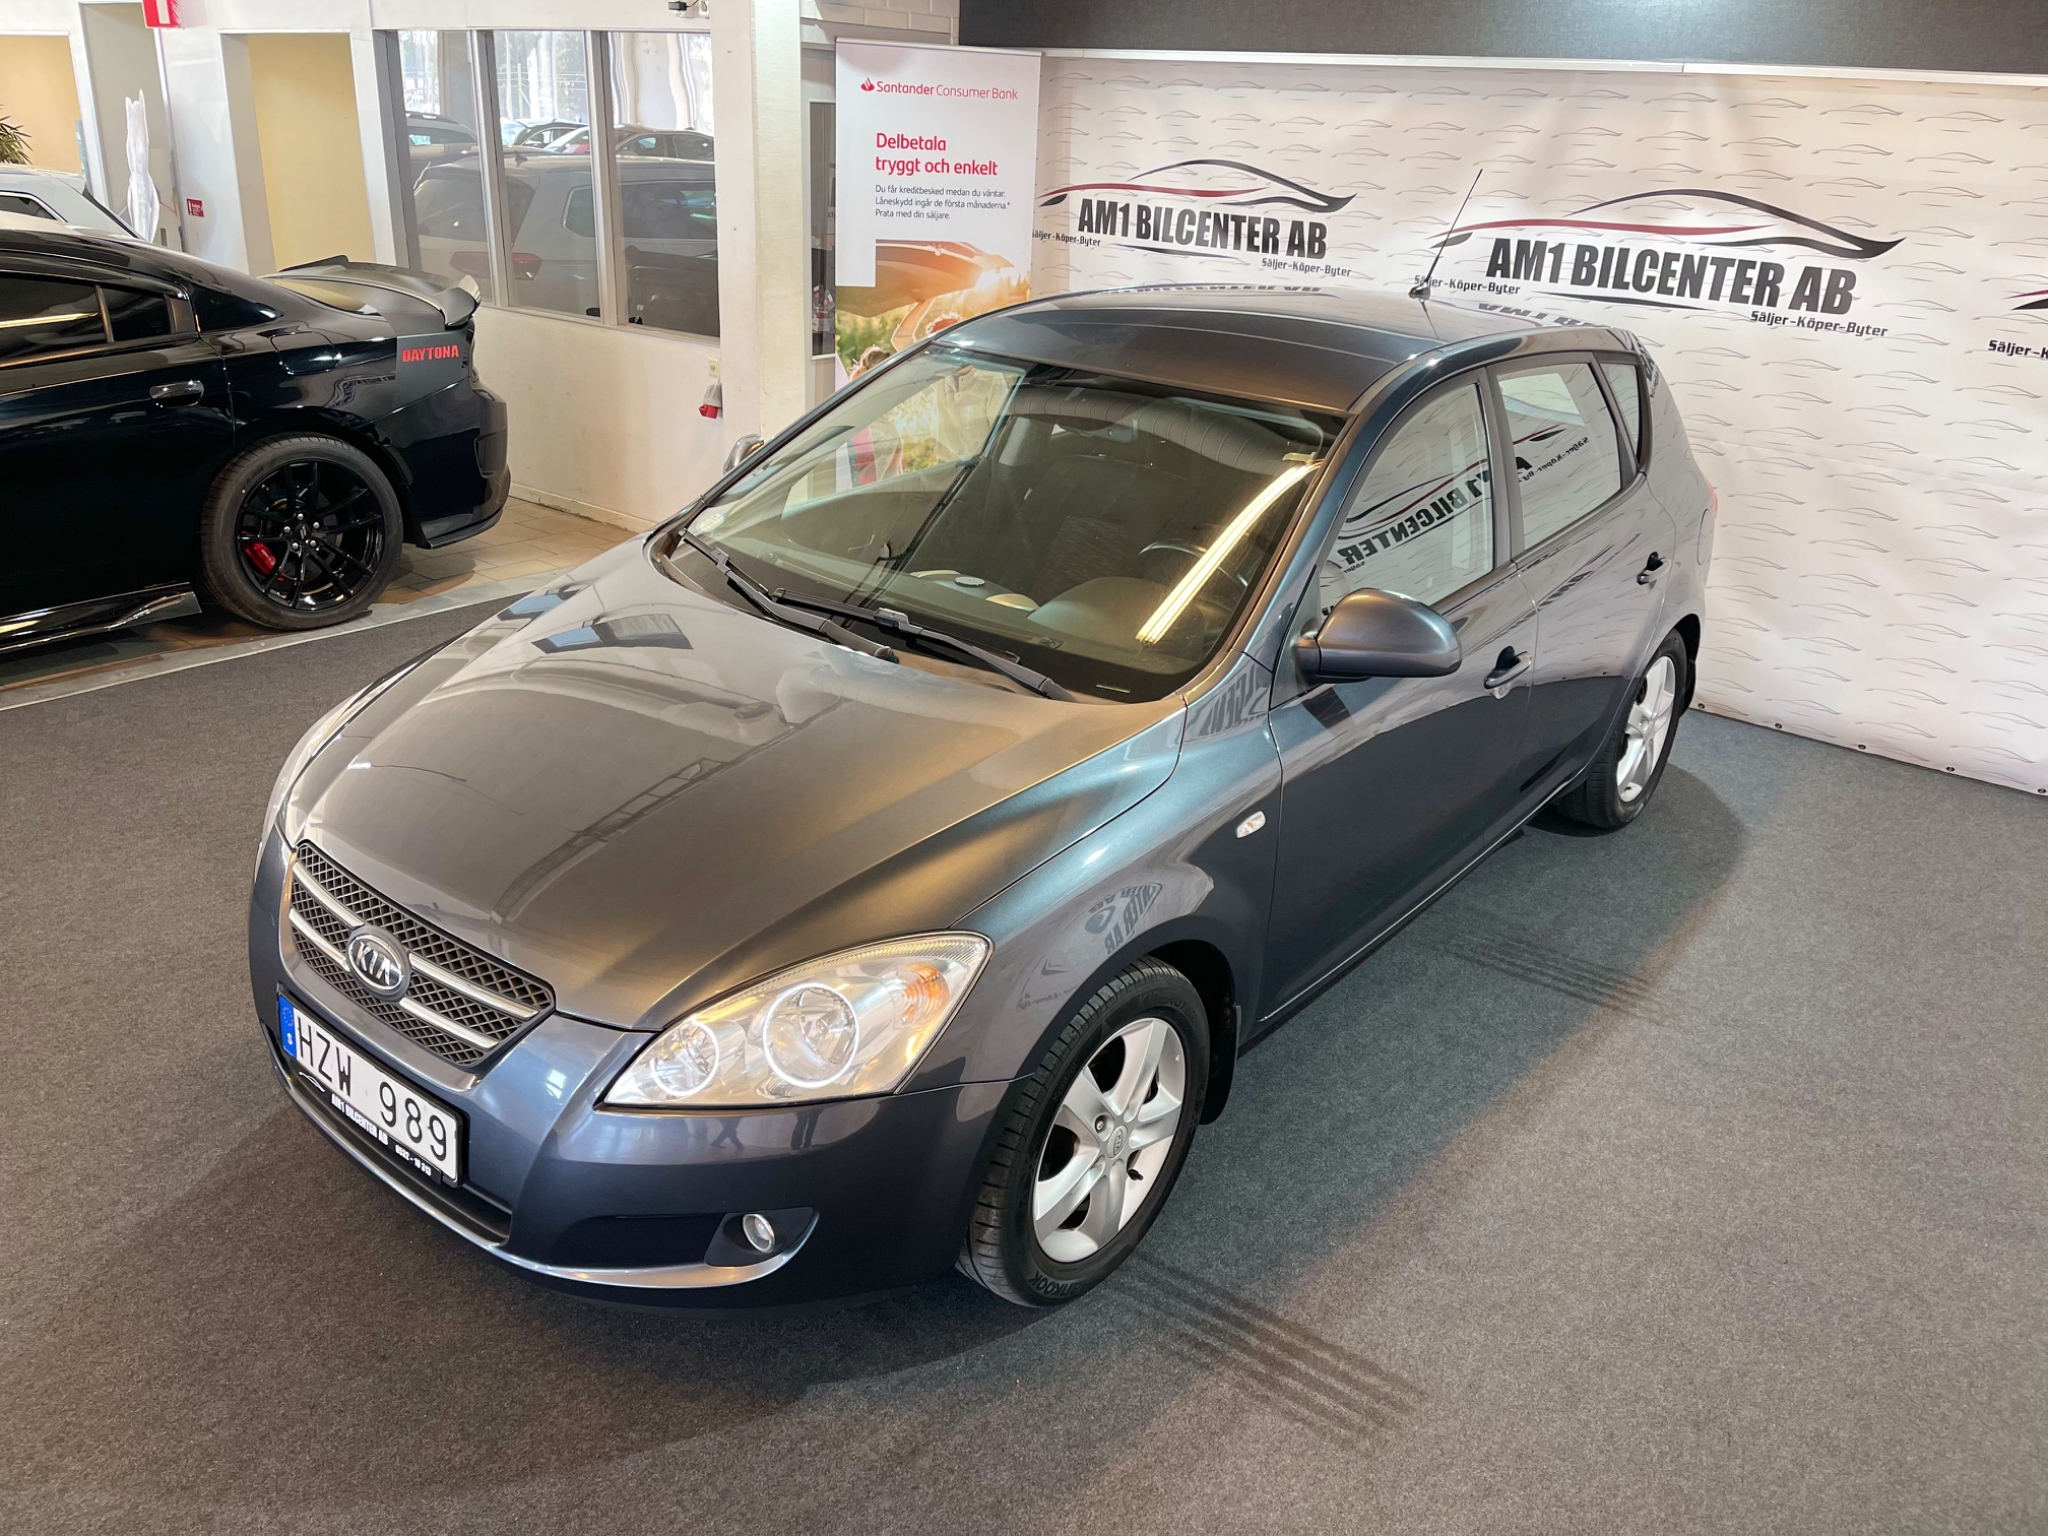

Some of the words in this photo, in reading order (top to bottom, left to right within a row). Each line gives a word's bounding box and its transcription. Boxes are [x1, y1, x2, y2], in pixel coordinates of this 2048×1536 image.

[876, 81, 934, 95] Santander
[936, 85, 990, 98] Consumer
[992, 87, 1018, 100] Bank
[876, 132, 946, 151] Delbetala
[876, 156, 921, 176] tryggt
[924, 158, 950, 173] och
[954, 160, 998, 176] enkelt
[875, 184, 886, 193] Du
[887, 185, 897, 194] får
[899, 186, 945, 196] kreditbesked
[946, 188, 970, 196] medan
[971, 188, 981, 197] du
[982, 189, 1006, 198] väntar.
[875, 196, 913, 207] Låneskydd
[914, 198, 932, 209] ingår
[933, 199, 943, 207] de
[944, 200, 965, 208] första
[875, 208, 894, 217] Prata
[895, 209, 912, 218] med
[913, 210, 925, 219] din
[926, 210, 950, 221] säljare.
[1078, 198, 1130, 237] AM1
[1136, 203, 1280, 255] BILCENTER
[1286, 219, 1328, 259] AB
[1261, 257, 1352, 277] Säljer-Köper-Byter
[1486, 237, 1563, 283] AM1
[1570, 243, 1787, 307] BILCENTER
[1788, 265, 1857, 315] AB
[1414, 274, 1521, 294] Säjer-Köper-Byter
[1750, 310, 1889, 338] Säljer-Köper-Byter
[402, 345, 459, 362] DAYTONA
[355, 941, 391, 986] KIA
[298, 1016, 351, 1098] HZW
[379, 1081, 447, 1161] 989
